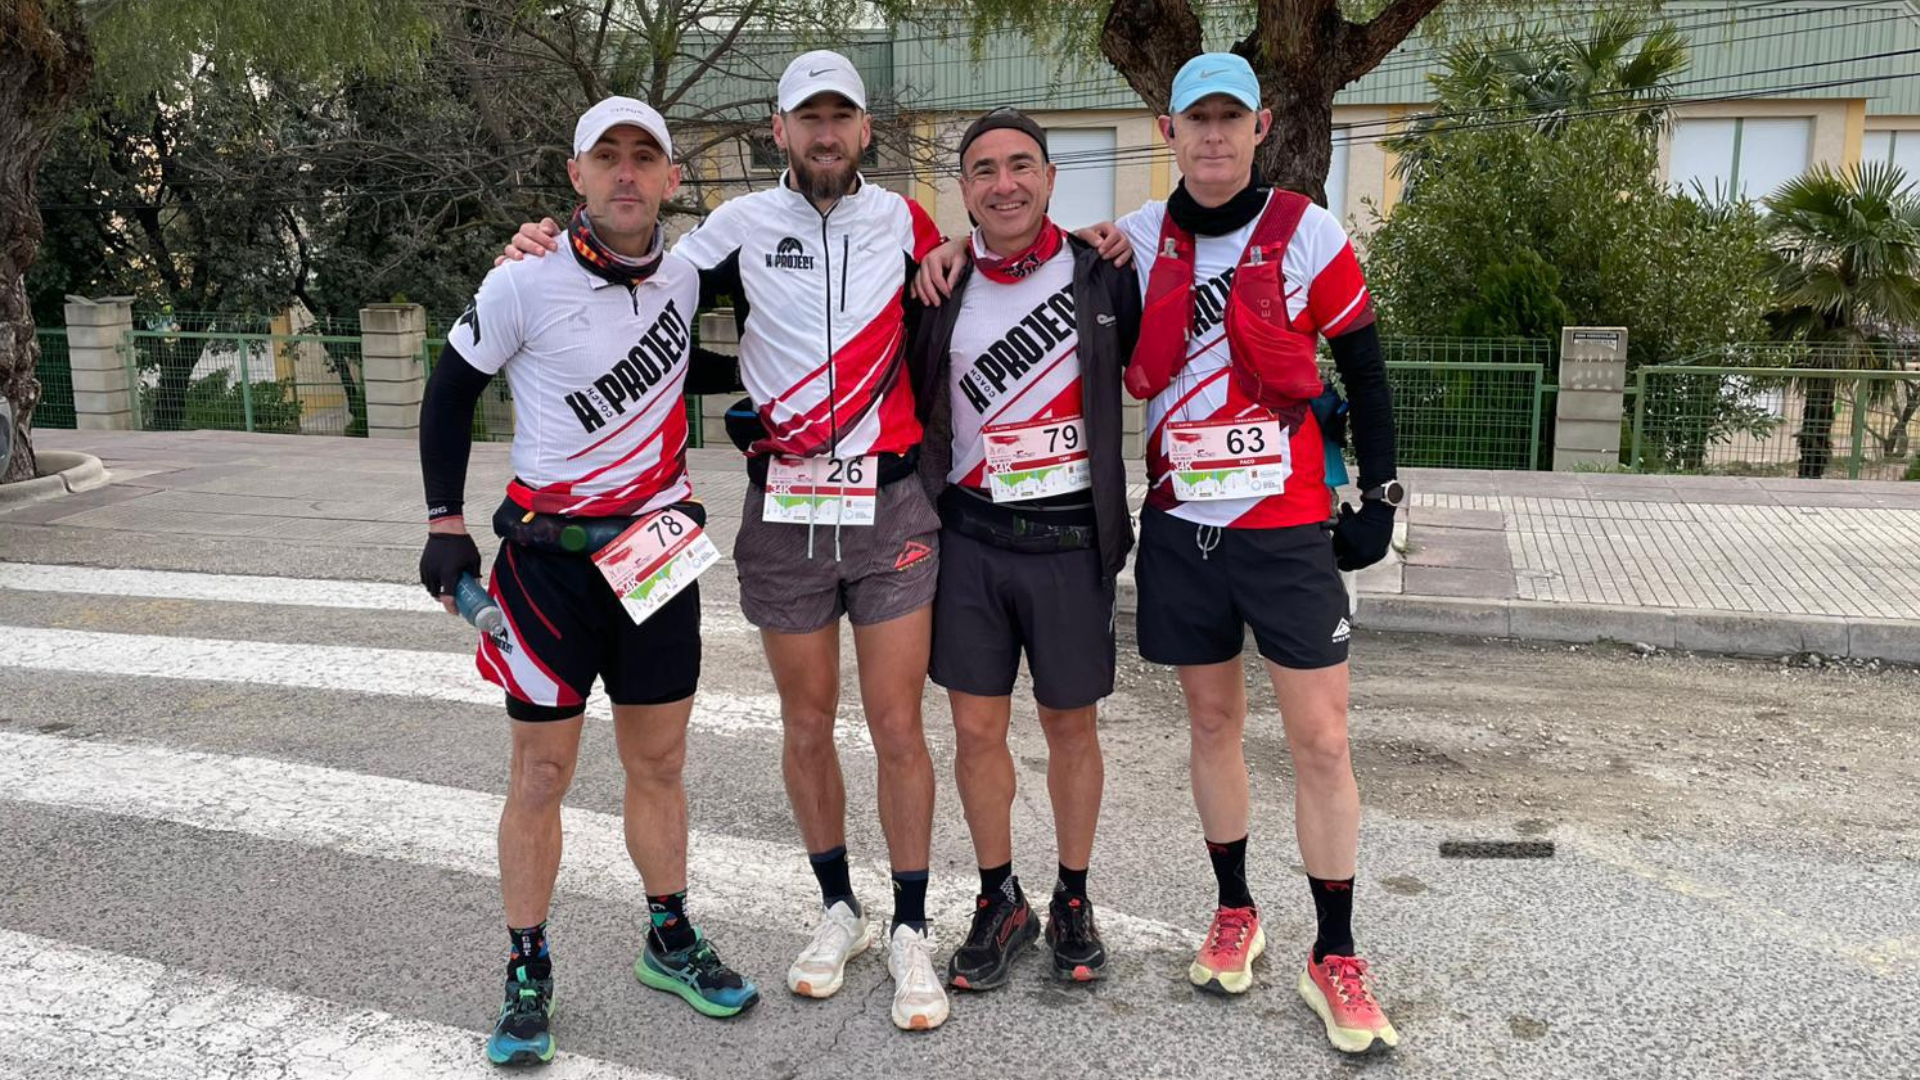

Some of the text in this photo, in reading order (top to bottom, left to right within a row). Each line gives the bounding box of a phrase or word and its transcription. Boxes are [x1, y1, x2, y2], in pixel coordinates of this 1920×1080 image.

[774, 254, 815, 270] PROJECT
[593, 298, 690, 415] PROJECT
[970, 368, 996, 398] COACH
[586, 387, 614, 418] COACH
[1042, 424, 1079, 453] 79
[1226, 426, 1265, 455] 63
[826, 458, 863, 484] 26
[646, 514, 684, 548] 78
